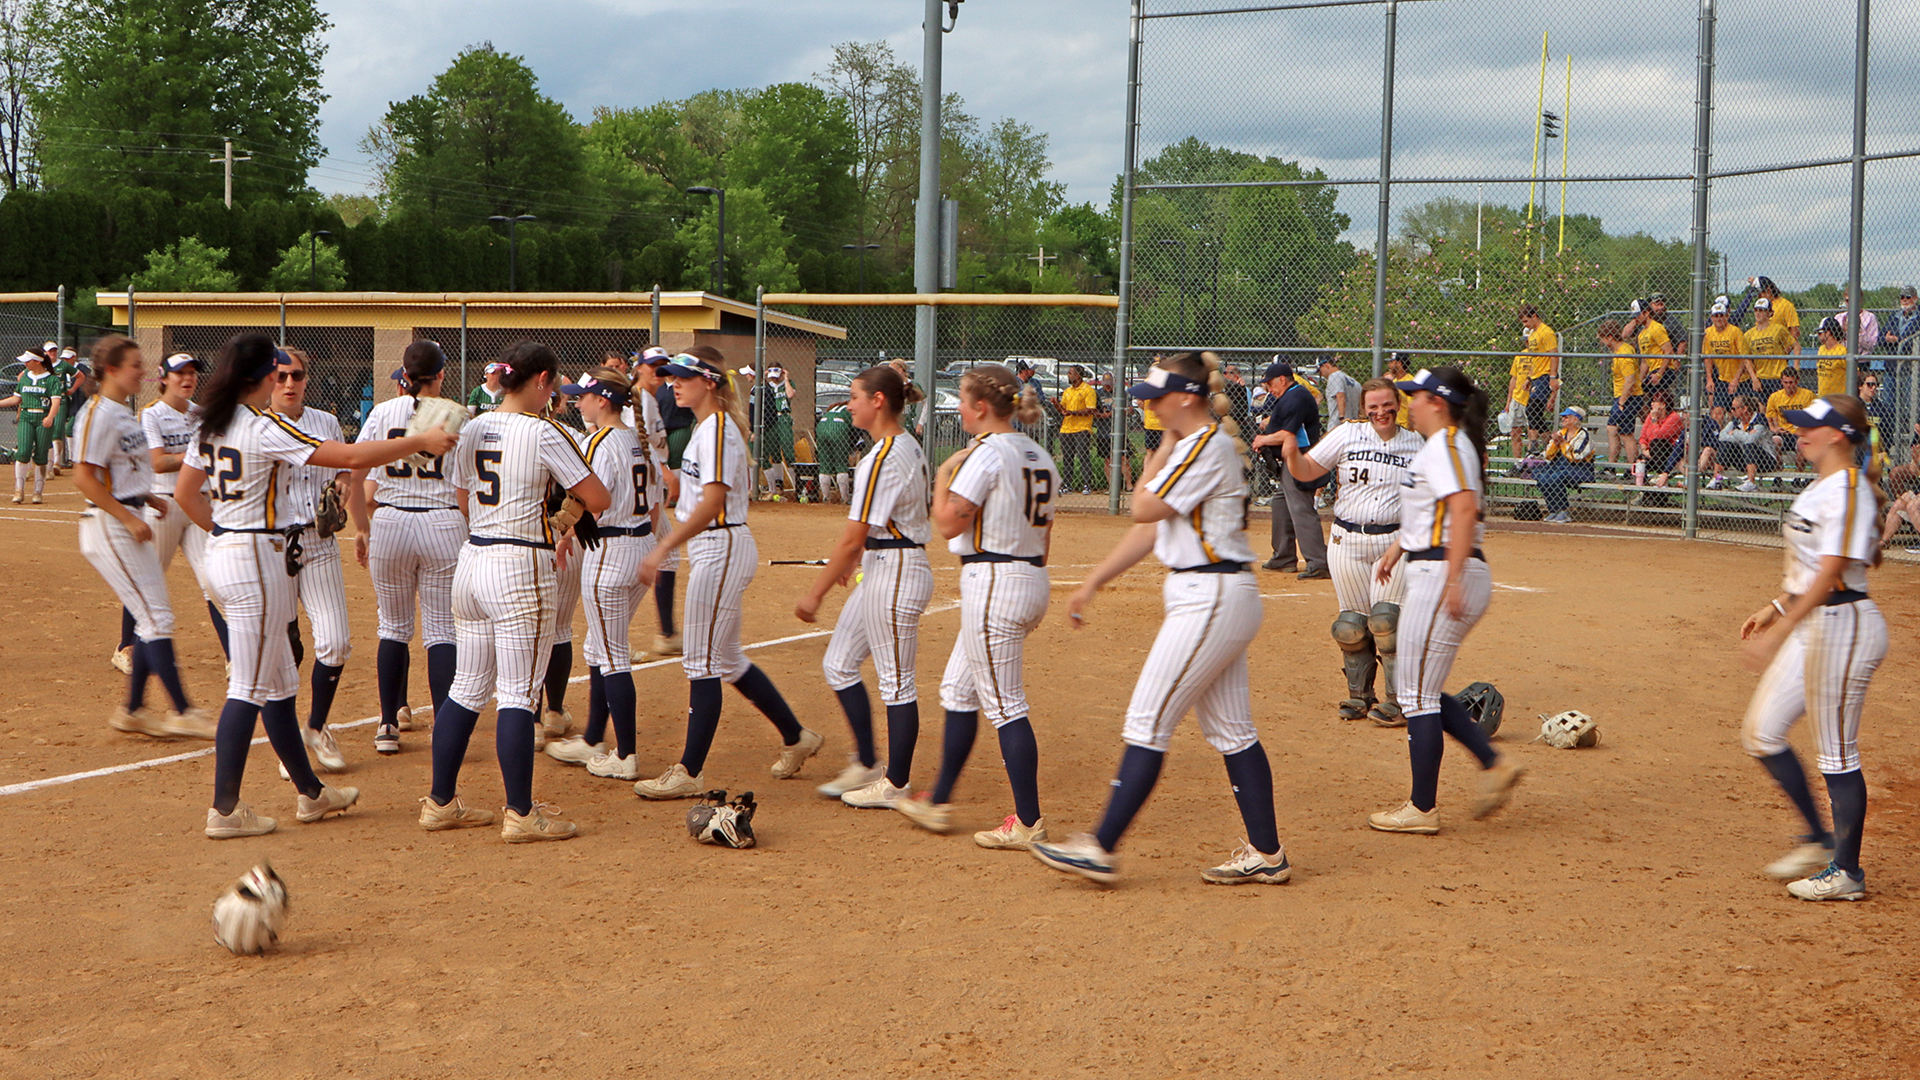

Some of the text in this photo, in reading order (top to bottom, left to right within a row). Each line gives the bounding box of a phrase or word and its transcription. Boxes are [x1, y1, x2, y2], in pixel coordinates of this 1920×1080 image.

[22, 386, 47, 394] DREW
[199, 441, 245, 503] 22
[475, 450, 503, 507] 5
[631, 463, 649, 517] 8
[1022, 466, 1052, 528] 12
[1348, 467, 1370, 485] 34
